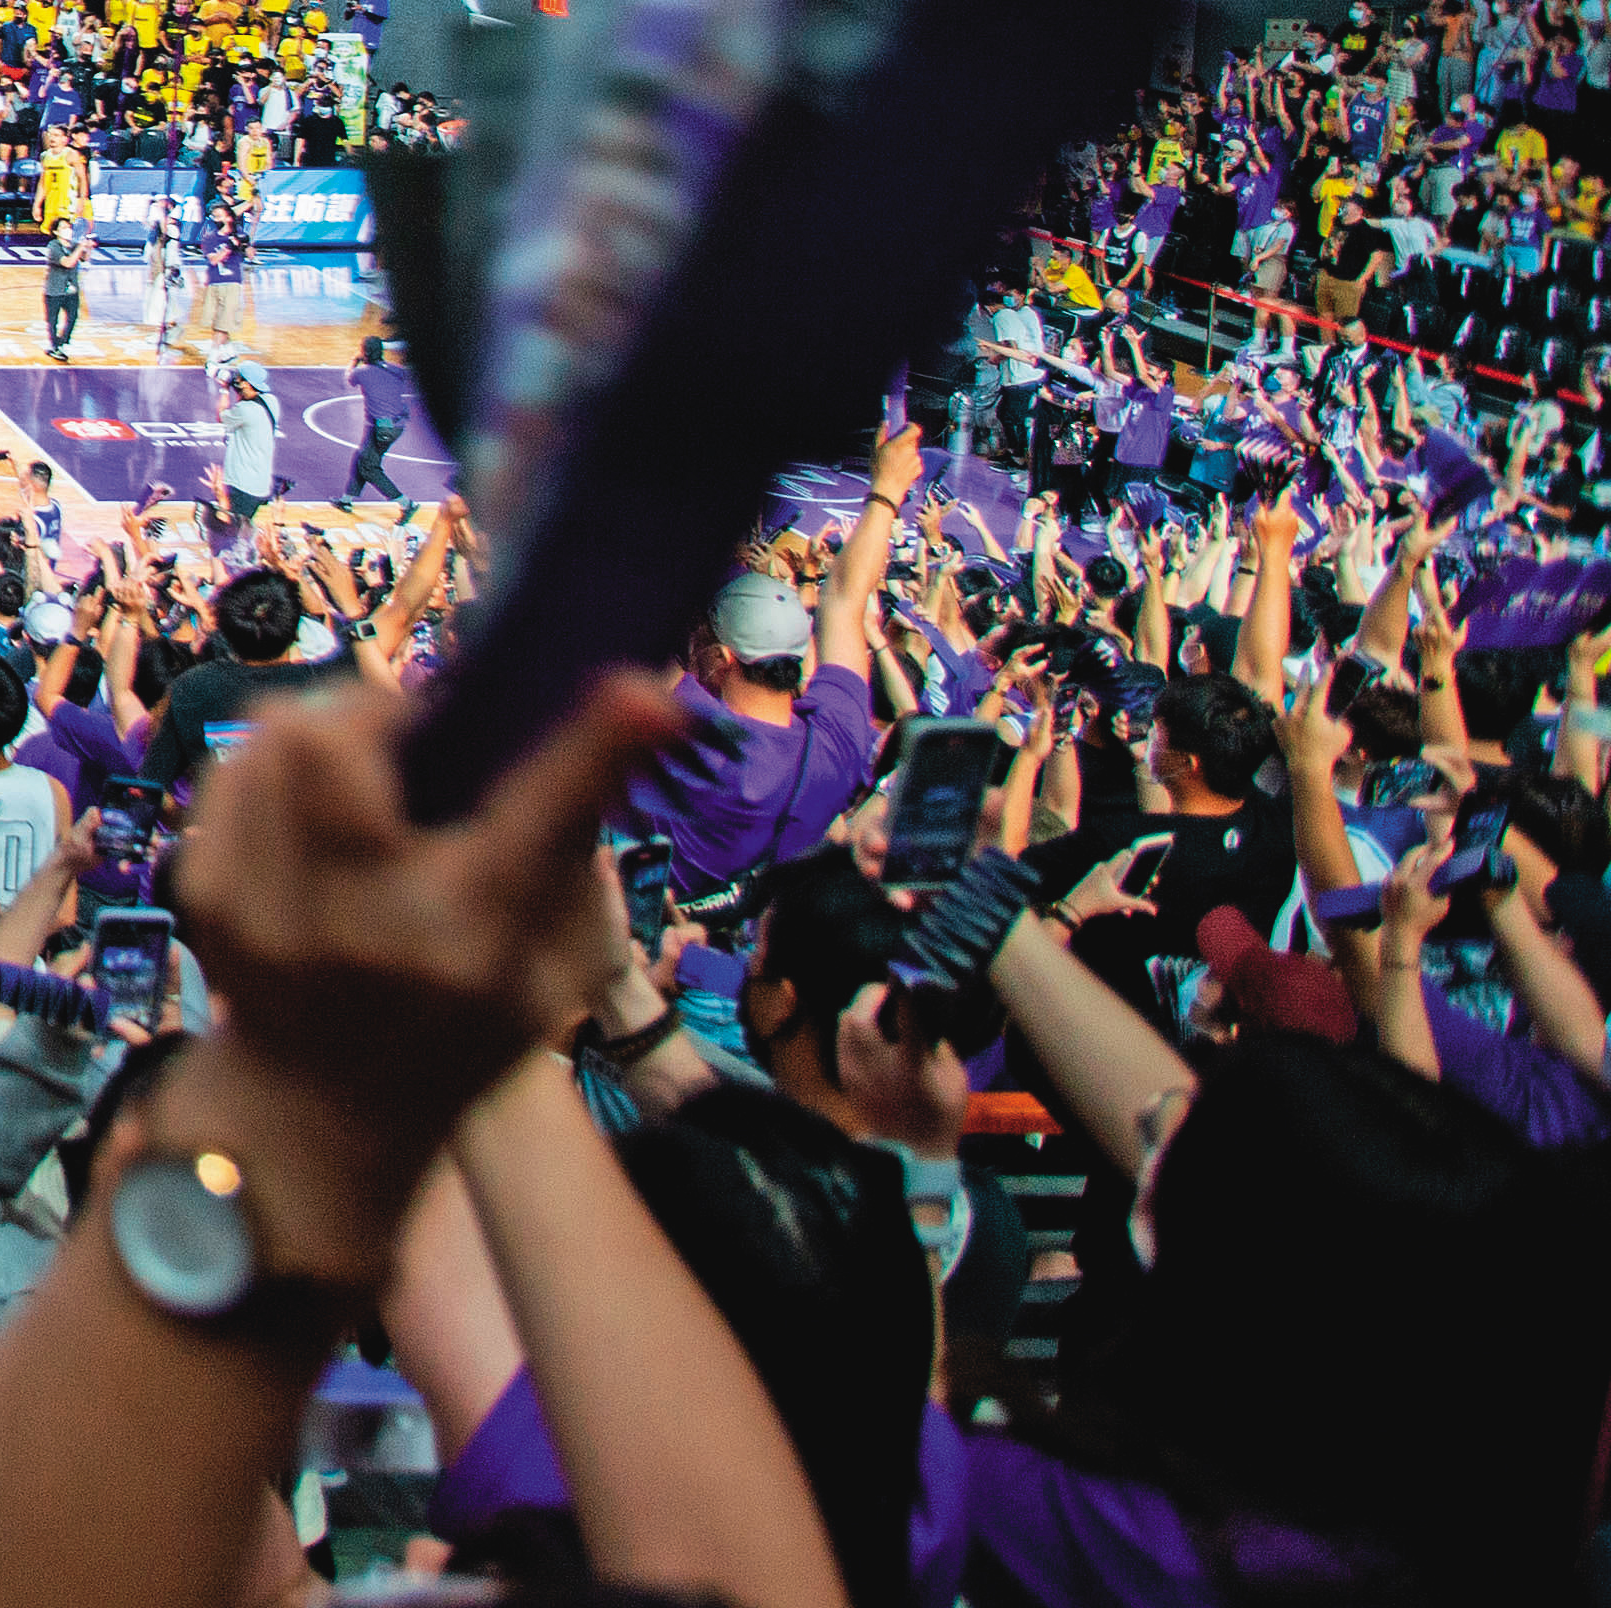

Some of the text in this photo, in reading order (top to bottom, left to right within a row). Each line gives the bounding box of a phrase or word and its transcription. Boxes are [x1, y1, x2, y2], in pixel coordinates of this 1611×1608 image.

[1352, 118, 1367, 133] 6
[262, 193, 360, 223] 注防護
